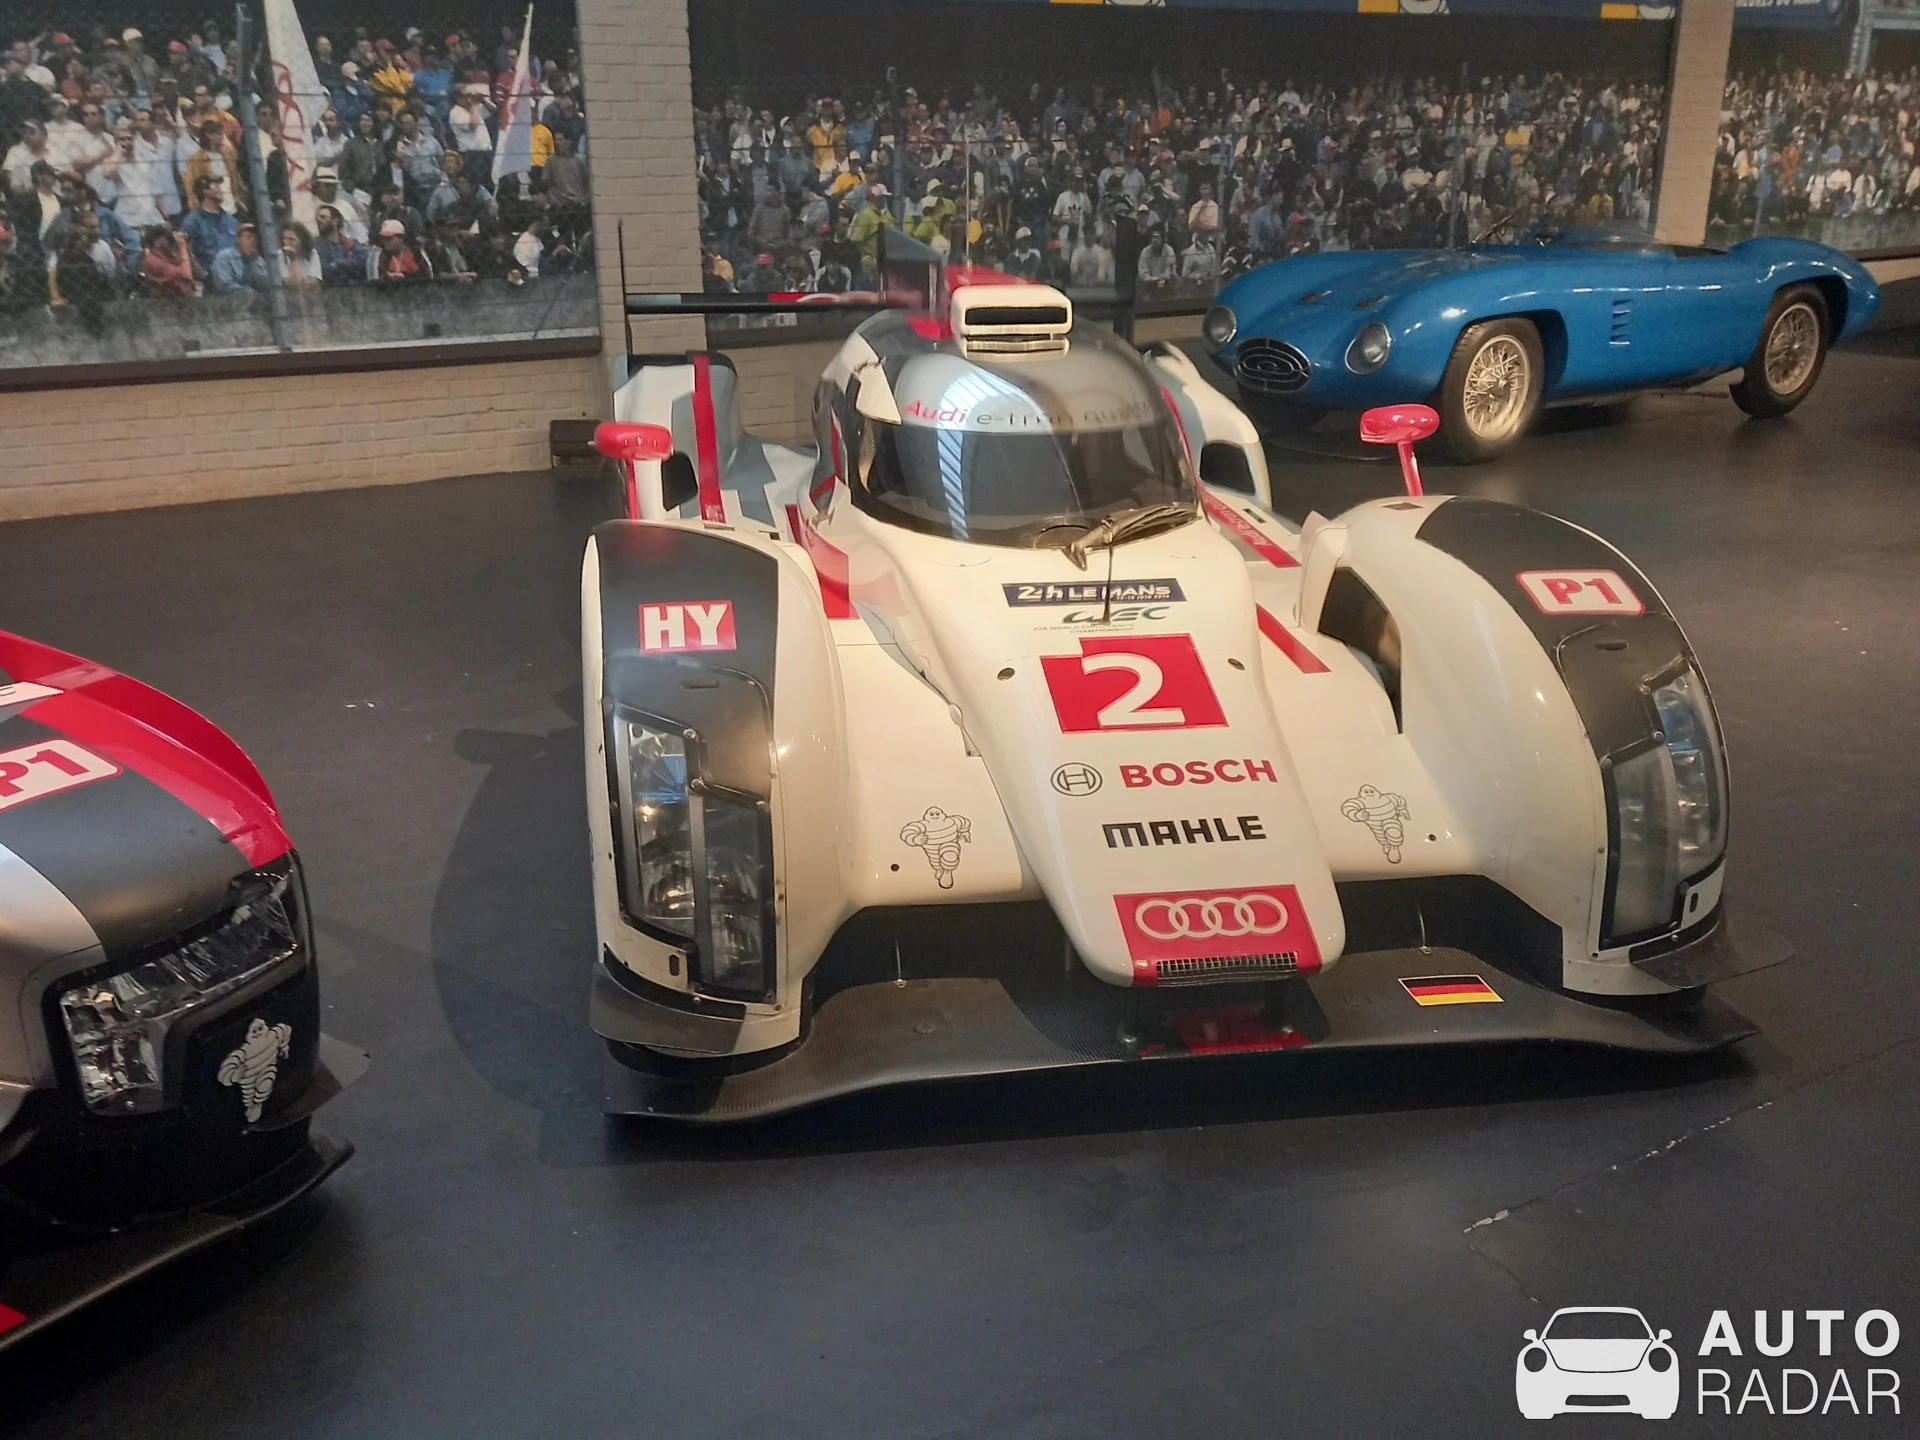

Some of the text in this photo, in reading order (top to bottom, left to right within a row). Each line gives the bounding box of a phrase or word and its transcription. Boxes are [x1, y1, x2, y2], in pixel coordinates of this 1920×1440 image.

[903, 399, 967, 424] Audi
[1068, 586, 1098, 601] LE
[1101, 584, 1171, 600] MANS
[1541, 577, 1625, 605] P1
[643, 602, 729, 649] HY
[1081, 652, 1186, 728] 2
[0, 749, 91, 798] P1
[1119, 759, 1278, 789] BOSCH
[1101, 815, 1267, 848] MAHLE
